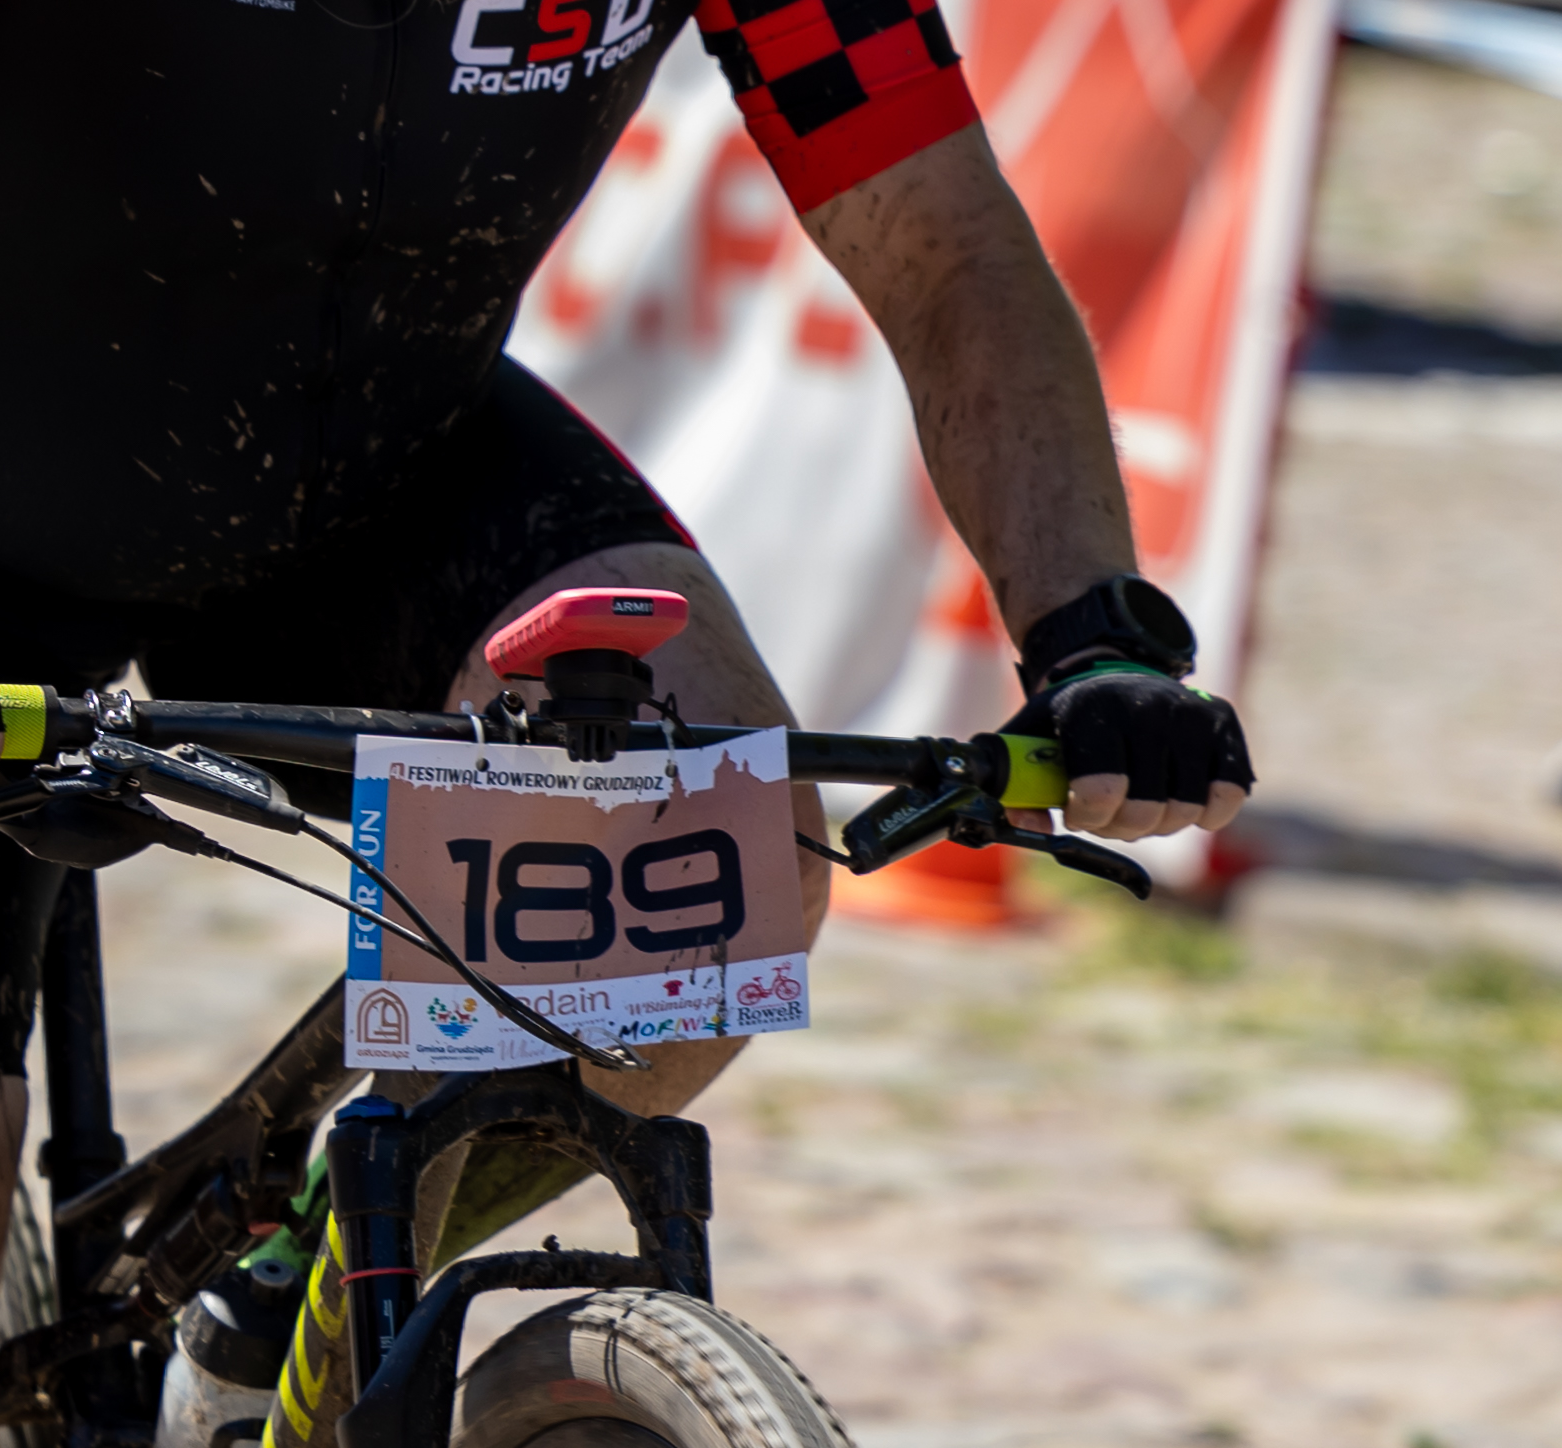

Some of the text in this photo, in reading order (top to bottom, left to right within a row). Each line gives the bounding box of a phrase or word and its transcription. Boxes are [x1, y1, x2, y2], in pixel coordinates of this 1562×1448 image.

[449, 24, 654, 94] Racing Team
[408, 765, 482, 786] FESTIWAL
[487, 770, 580, 790] ROWEROWY
[583, 775, 664, 795] GRUDZIĄDZ
[354, 809, 382, 950] FOR UN
[446, 828, 746, 964] 189
